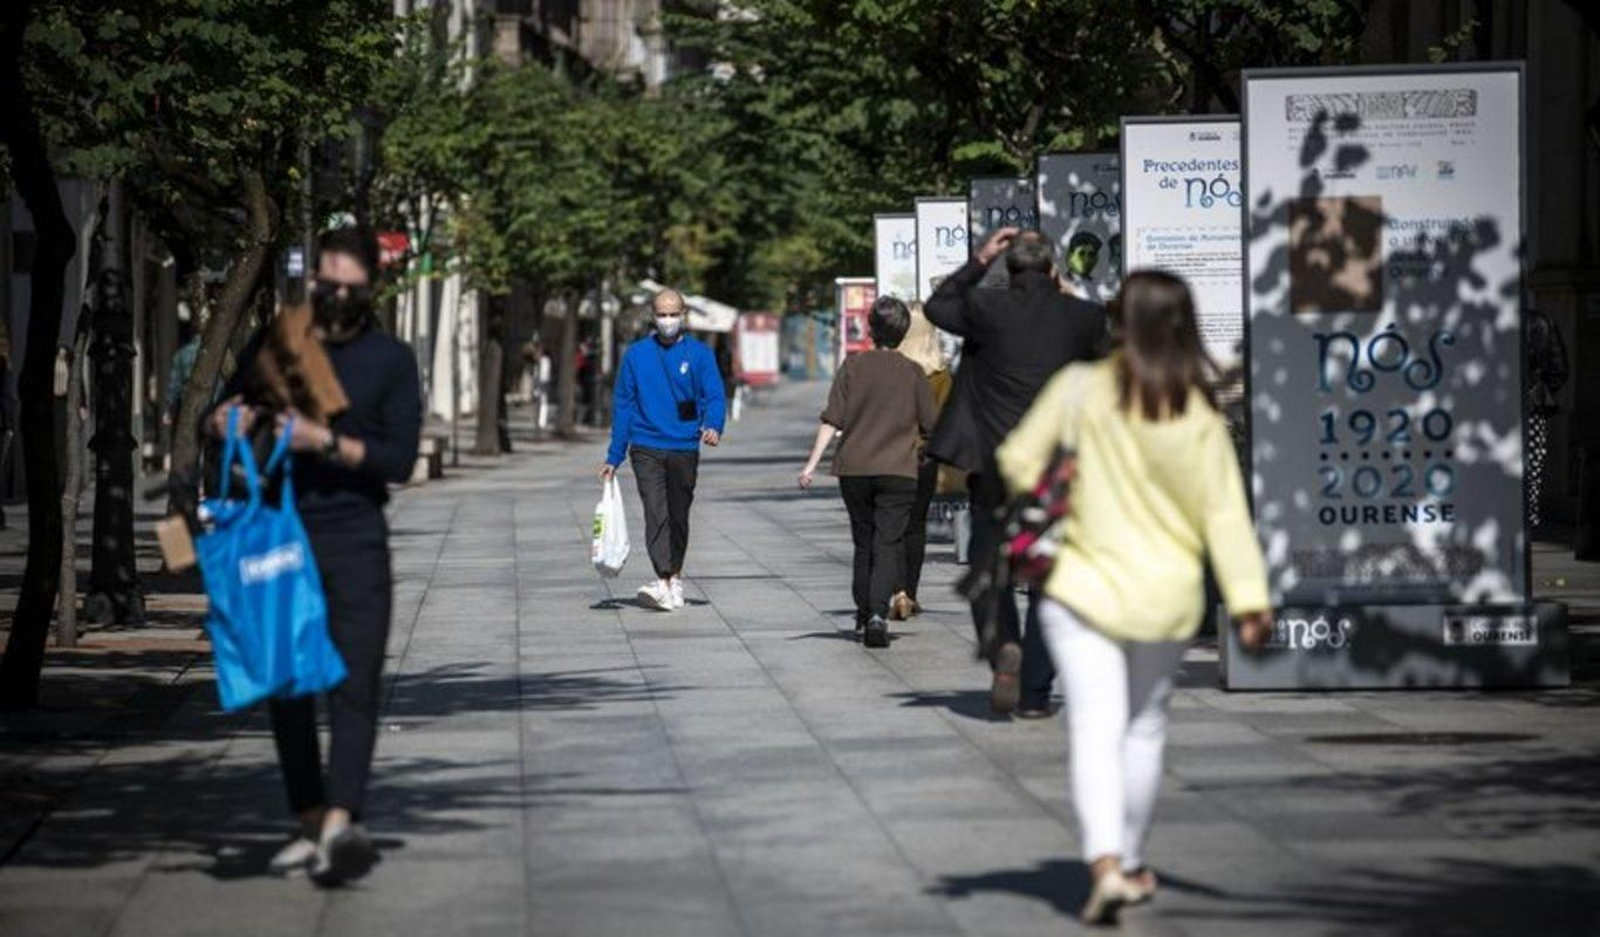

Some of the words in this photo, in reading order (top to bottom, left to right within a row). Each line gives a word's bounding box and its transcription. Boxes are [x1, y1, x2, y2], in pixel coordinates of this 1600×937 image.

[1143, 158, 1239, 173] Precedentes
[1159, 176, 1179, 190] de
[1313, 323, 1455, 394] nós
[1319, 410, 1454, 445] 1920
[1318, 464, 1455, 500] 2020
[1319, 504, 1456, 526] OURENSE
[1286, 614, 1351, 650] nós
